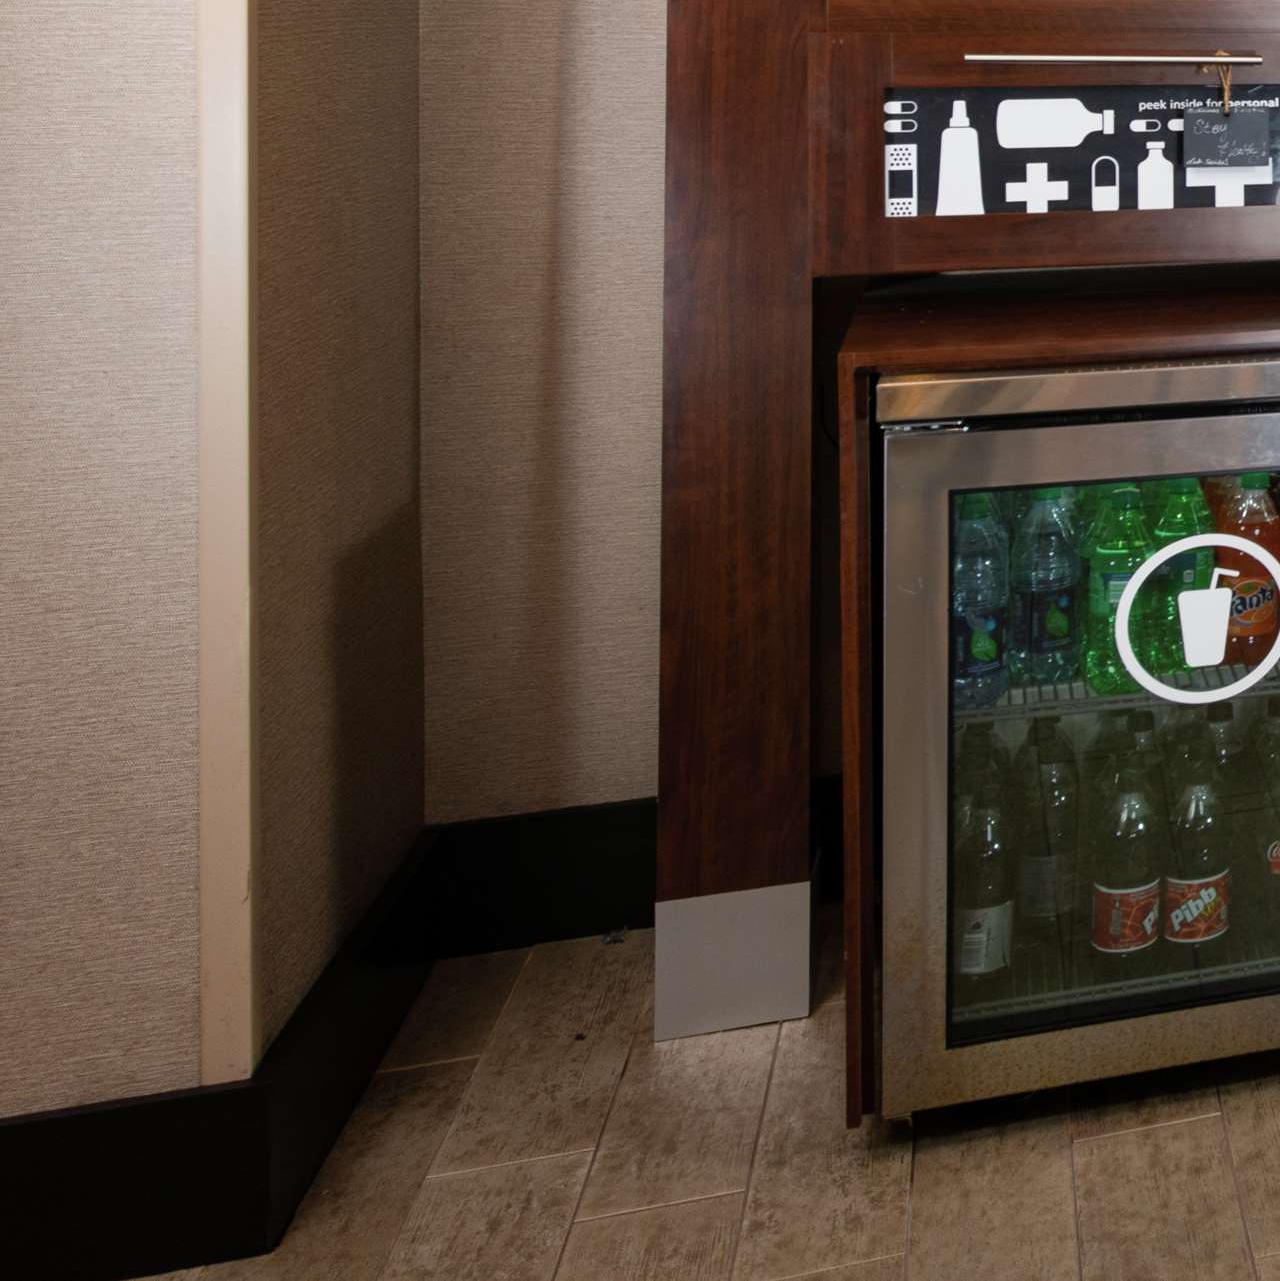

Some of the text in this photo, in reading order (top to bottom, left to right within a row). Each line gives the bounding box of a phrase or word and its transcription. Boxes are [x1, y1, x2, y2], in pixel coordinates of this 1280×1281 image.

[1138, 98, 1168, 112] peek
[1169, 98, 1203, 110] inside
[1205, 98, 1225, 109] for
[1227, 98, 1280, 111] personal
[1170, 886, 1218, 933] Pibb
